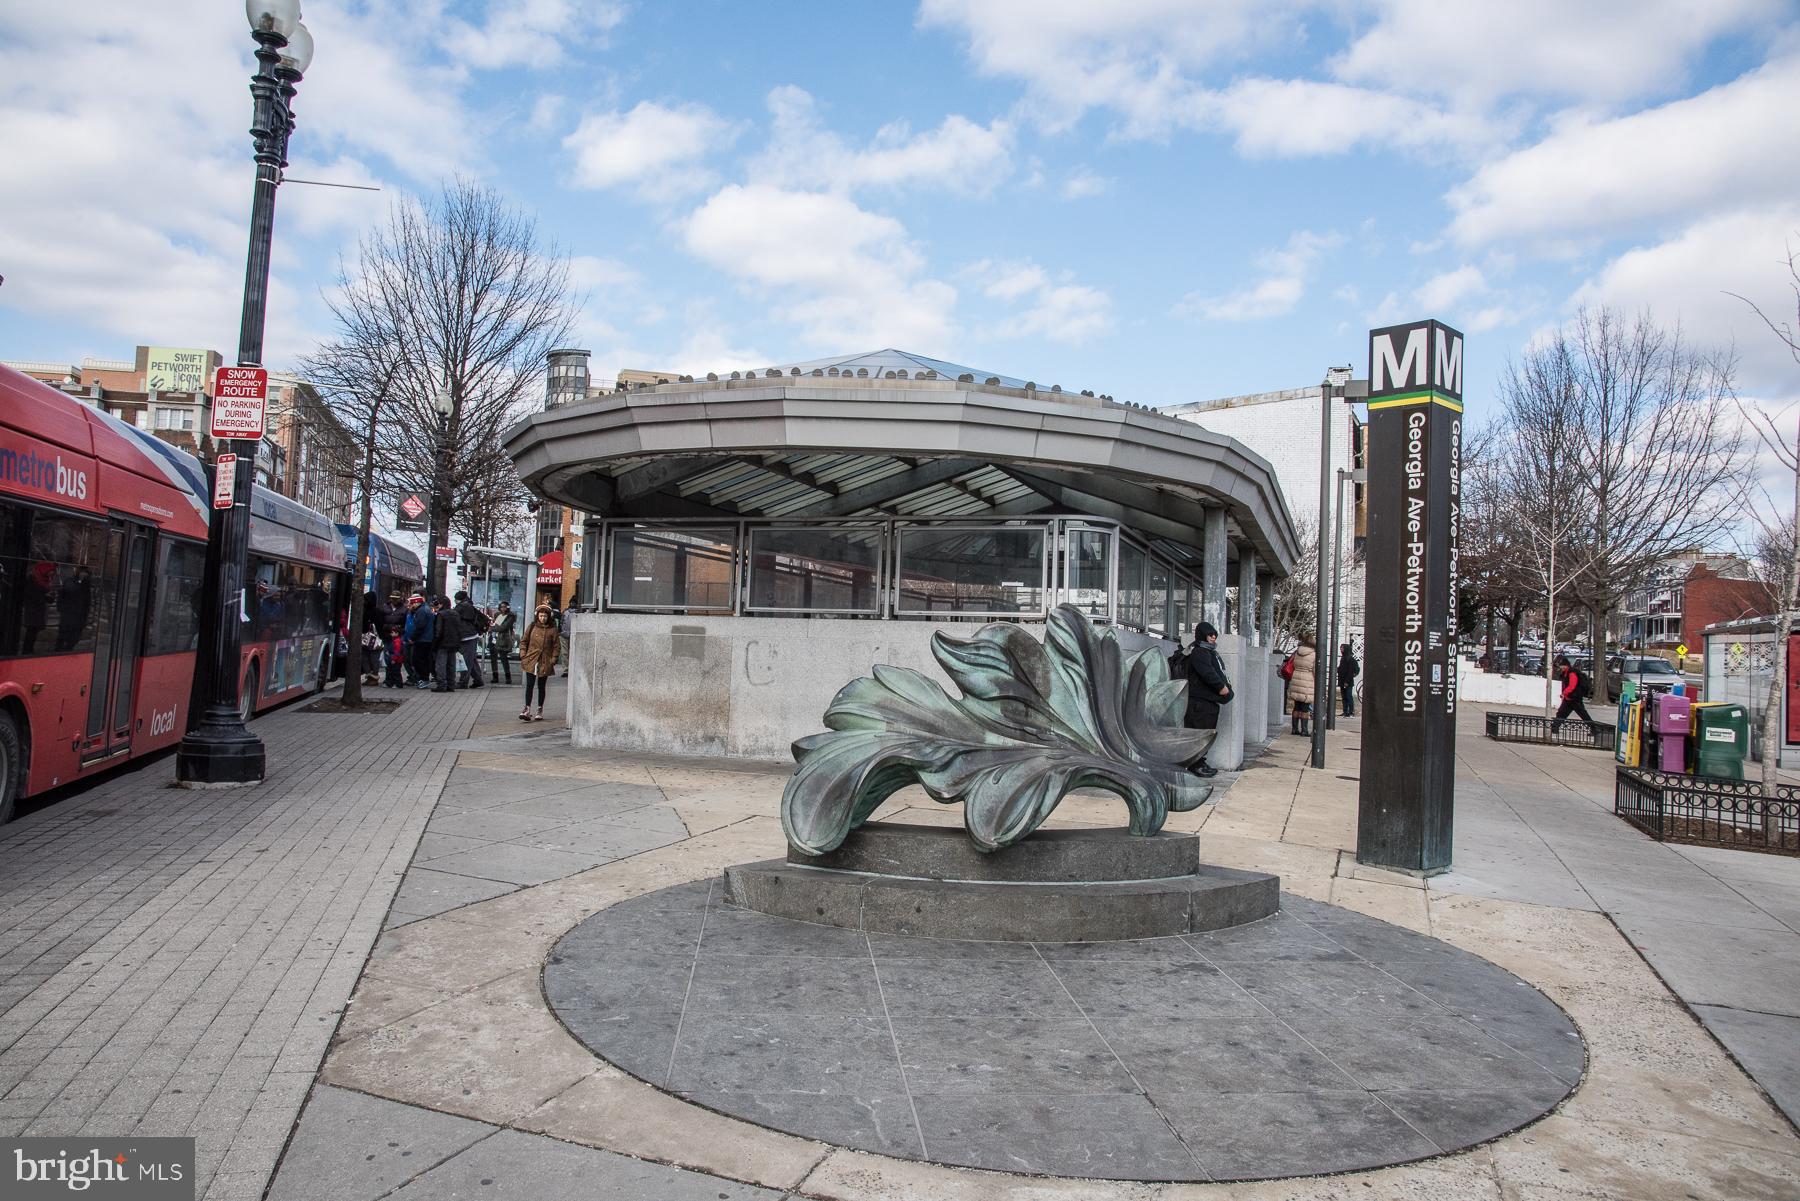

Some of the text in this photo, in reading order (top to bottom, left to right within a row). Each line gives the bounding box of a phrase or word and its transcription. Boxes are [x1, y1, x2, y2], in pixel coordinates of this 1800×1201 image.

[174, 353, 203, 363] SWIFT
[1372, 327, 1428, 392] M
[1434, 327, 1463, 395] M
[151, 361, 202, 373] PETWORTH
[227, 369, 257, 379] SNOW
[220, 379, 262, 387] EMERGENCY
[223, 386, 258, 397] ROUTE
[217, 400, 261, 409] NO PARKING
[225, 409, 252, 418] DURING
[215, 418, 259, 428] EMERGENCY
[0, 446, 87, 500] metrobus
[1403, 412, 1426, 712] Georgia Ave-Petworth Station
[1446, 420, 1461, 713] Georgia Ave-Petworth Station
[150, 703, 177, 737] local
